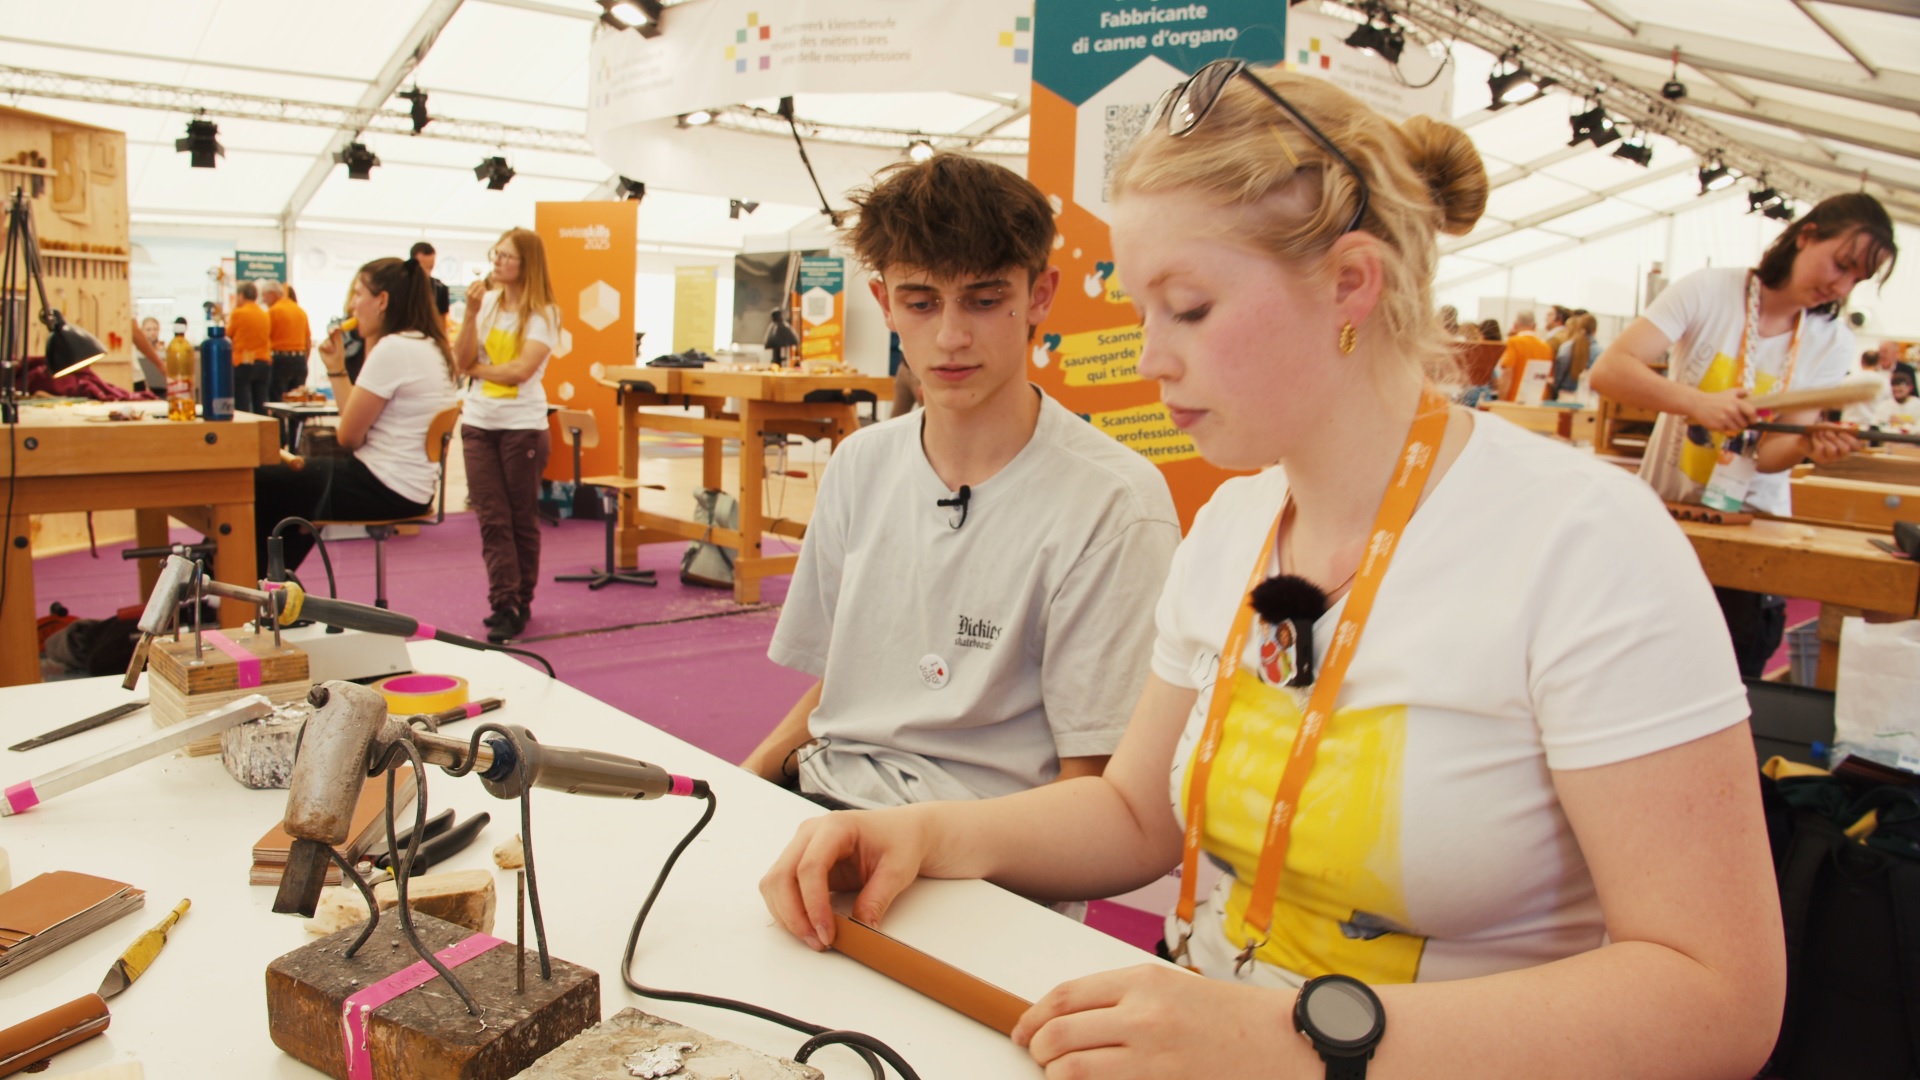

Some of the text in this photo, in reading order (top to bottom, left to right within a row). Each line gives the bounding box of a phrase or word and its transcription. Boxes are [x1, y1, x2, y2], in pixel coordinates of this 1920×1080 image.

[1100, 4, 1208, 28] Fabbricante
[1072, 27, 1239, 54] di canne d'organo
[1097, 331, 1142, 346] Scanne
[1064, 347, 1136, 368] sauvegarde
[1087, 367, 1107, 383] qui
[1101, 412, 1165, 427] Scansiona
[957, 615, 1003, 640] Dickies
